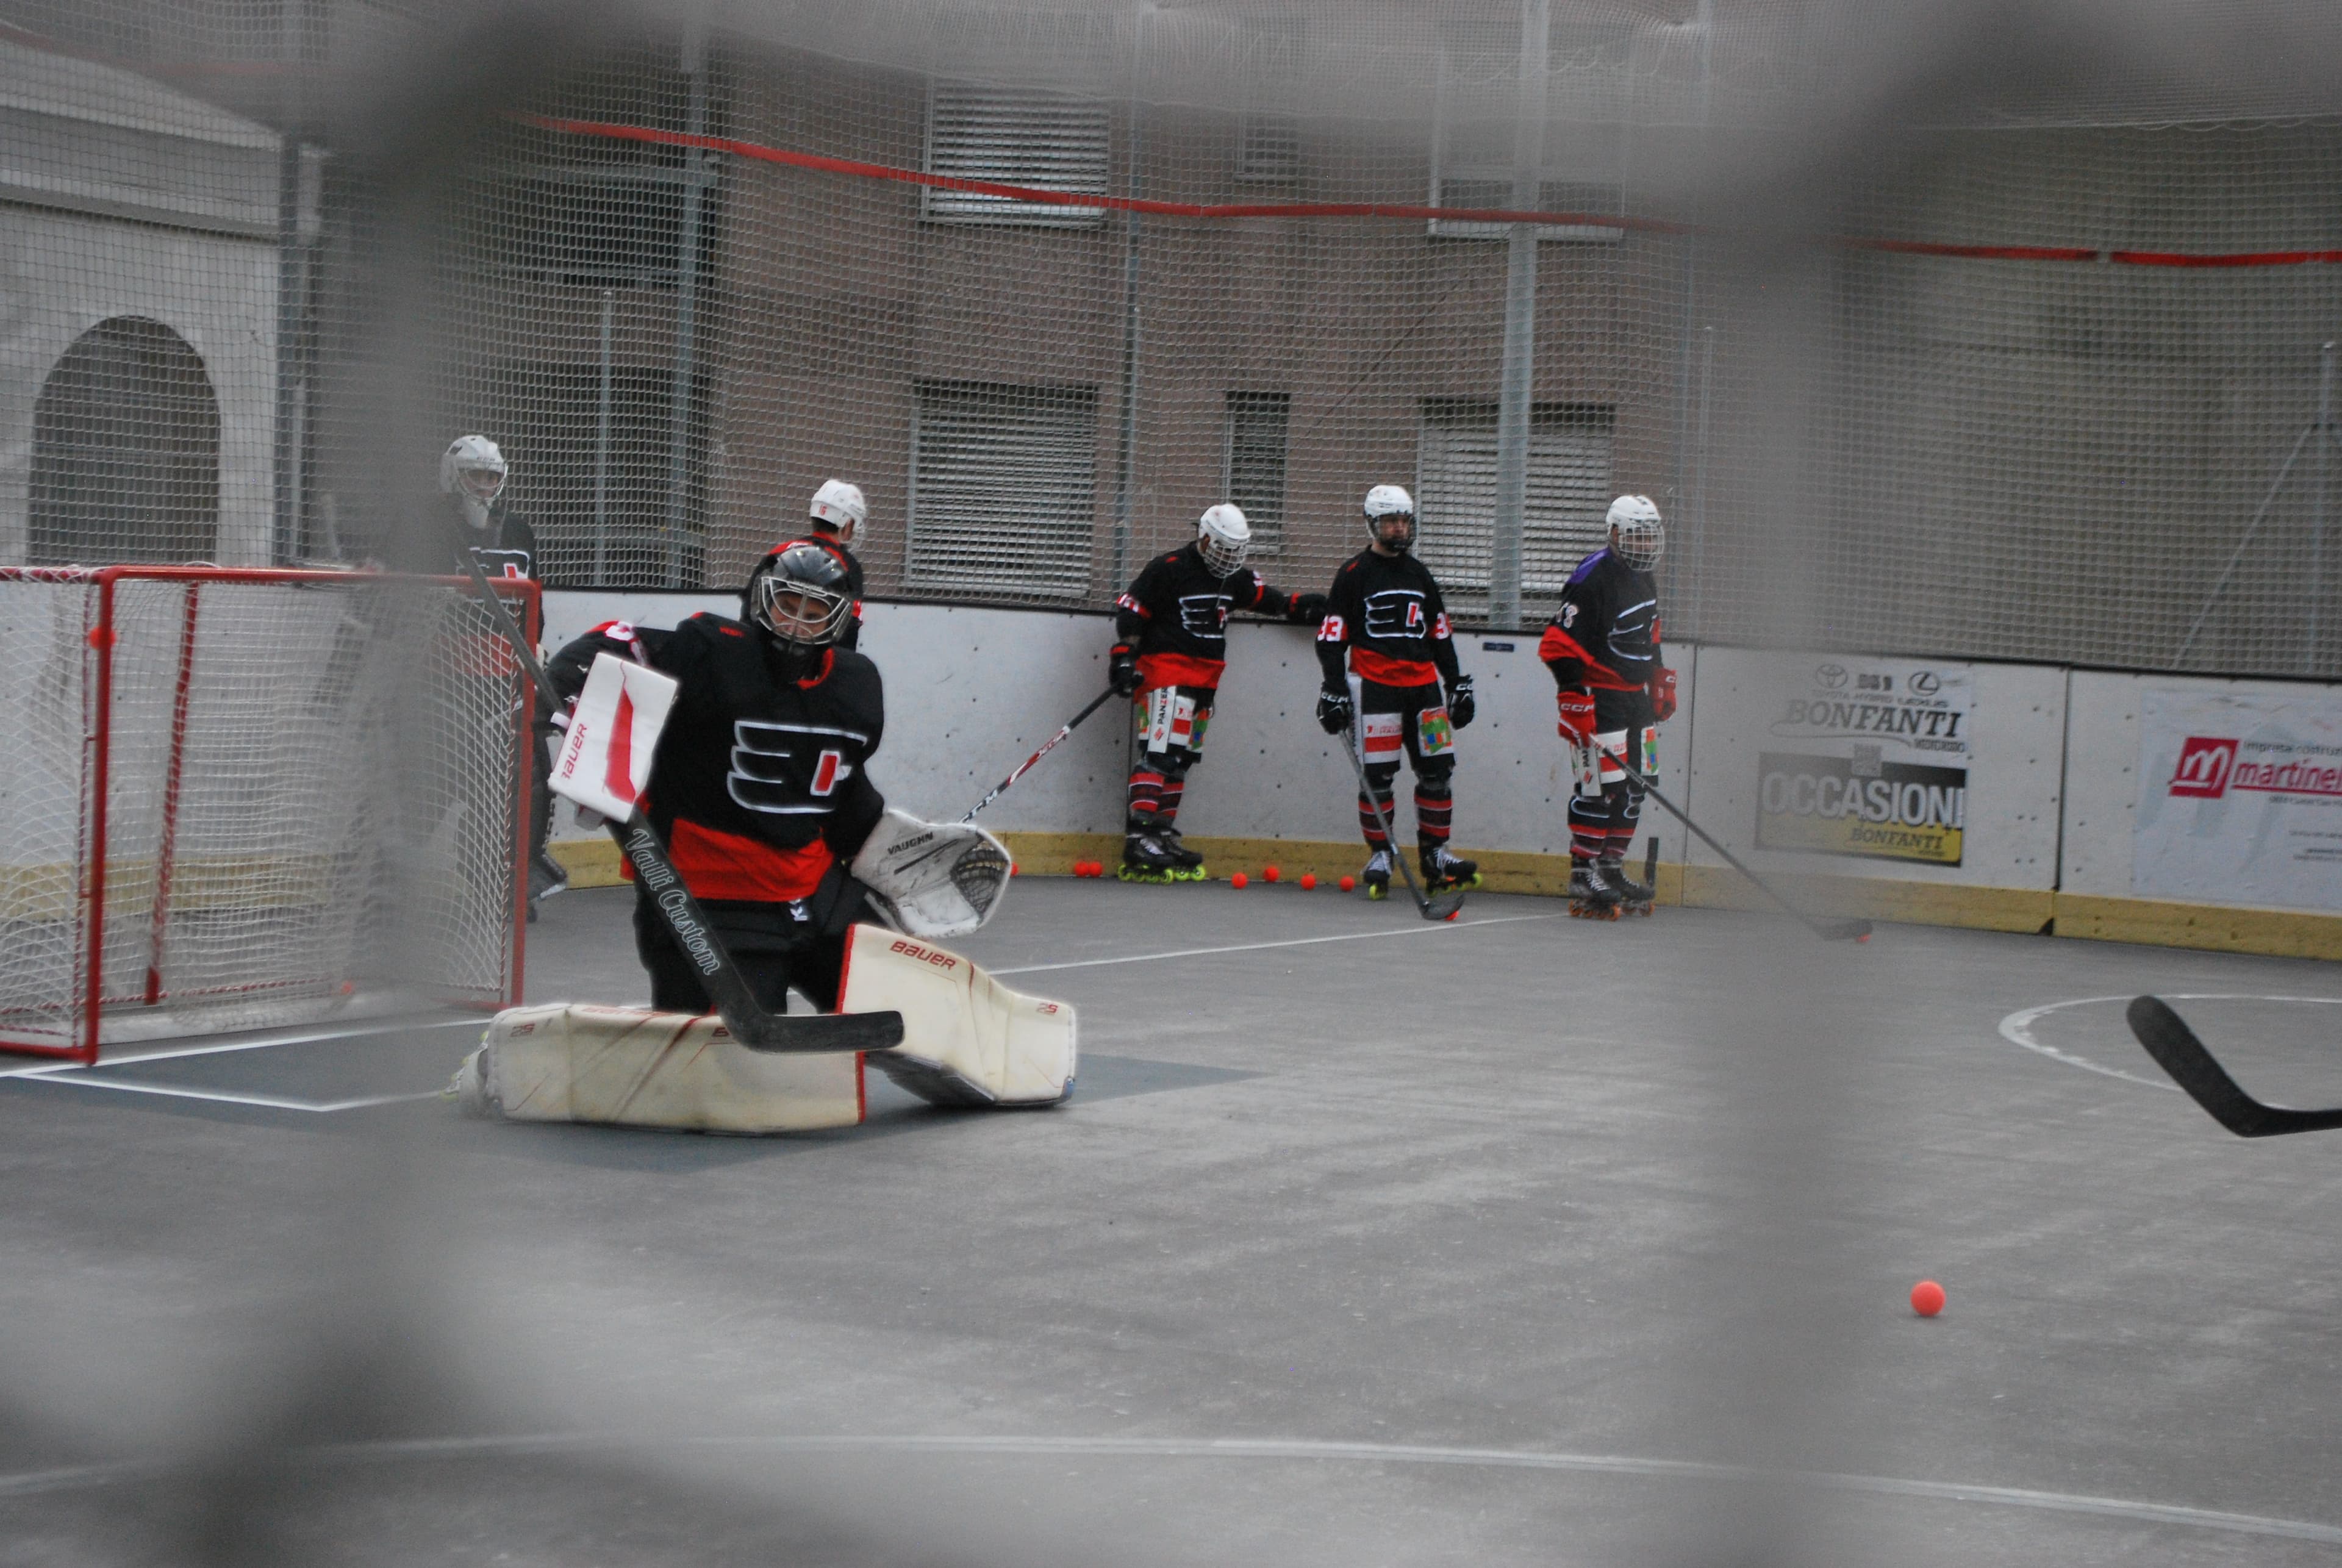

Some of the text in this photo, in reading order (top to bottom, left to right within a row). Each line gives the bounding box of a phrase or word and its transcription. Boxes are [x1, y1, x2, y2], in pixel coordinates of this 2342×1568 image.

[1786, 699, 1962, 738] BONFANTI
[1762, 771, 1965, 831] OCCASIONI
[887, 832, 934, 855] VAUGHN
[1852, 827, 1944, 850] BONFANTI
[659, 889, 720, 975] Custom
[890, 940, 956, 970] BAUER
